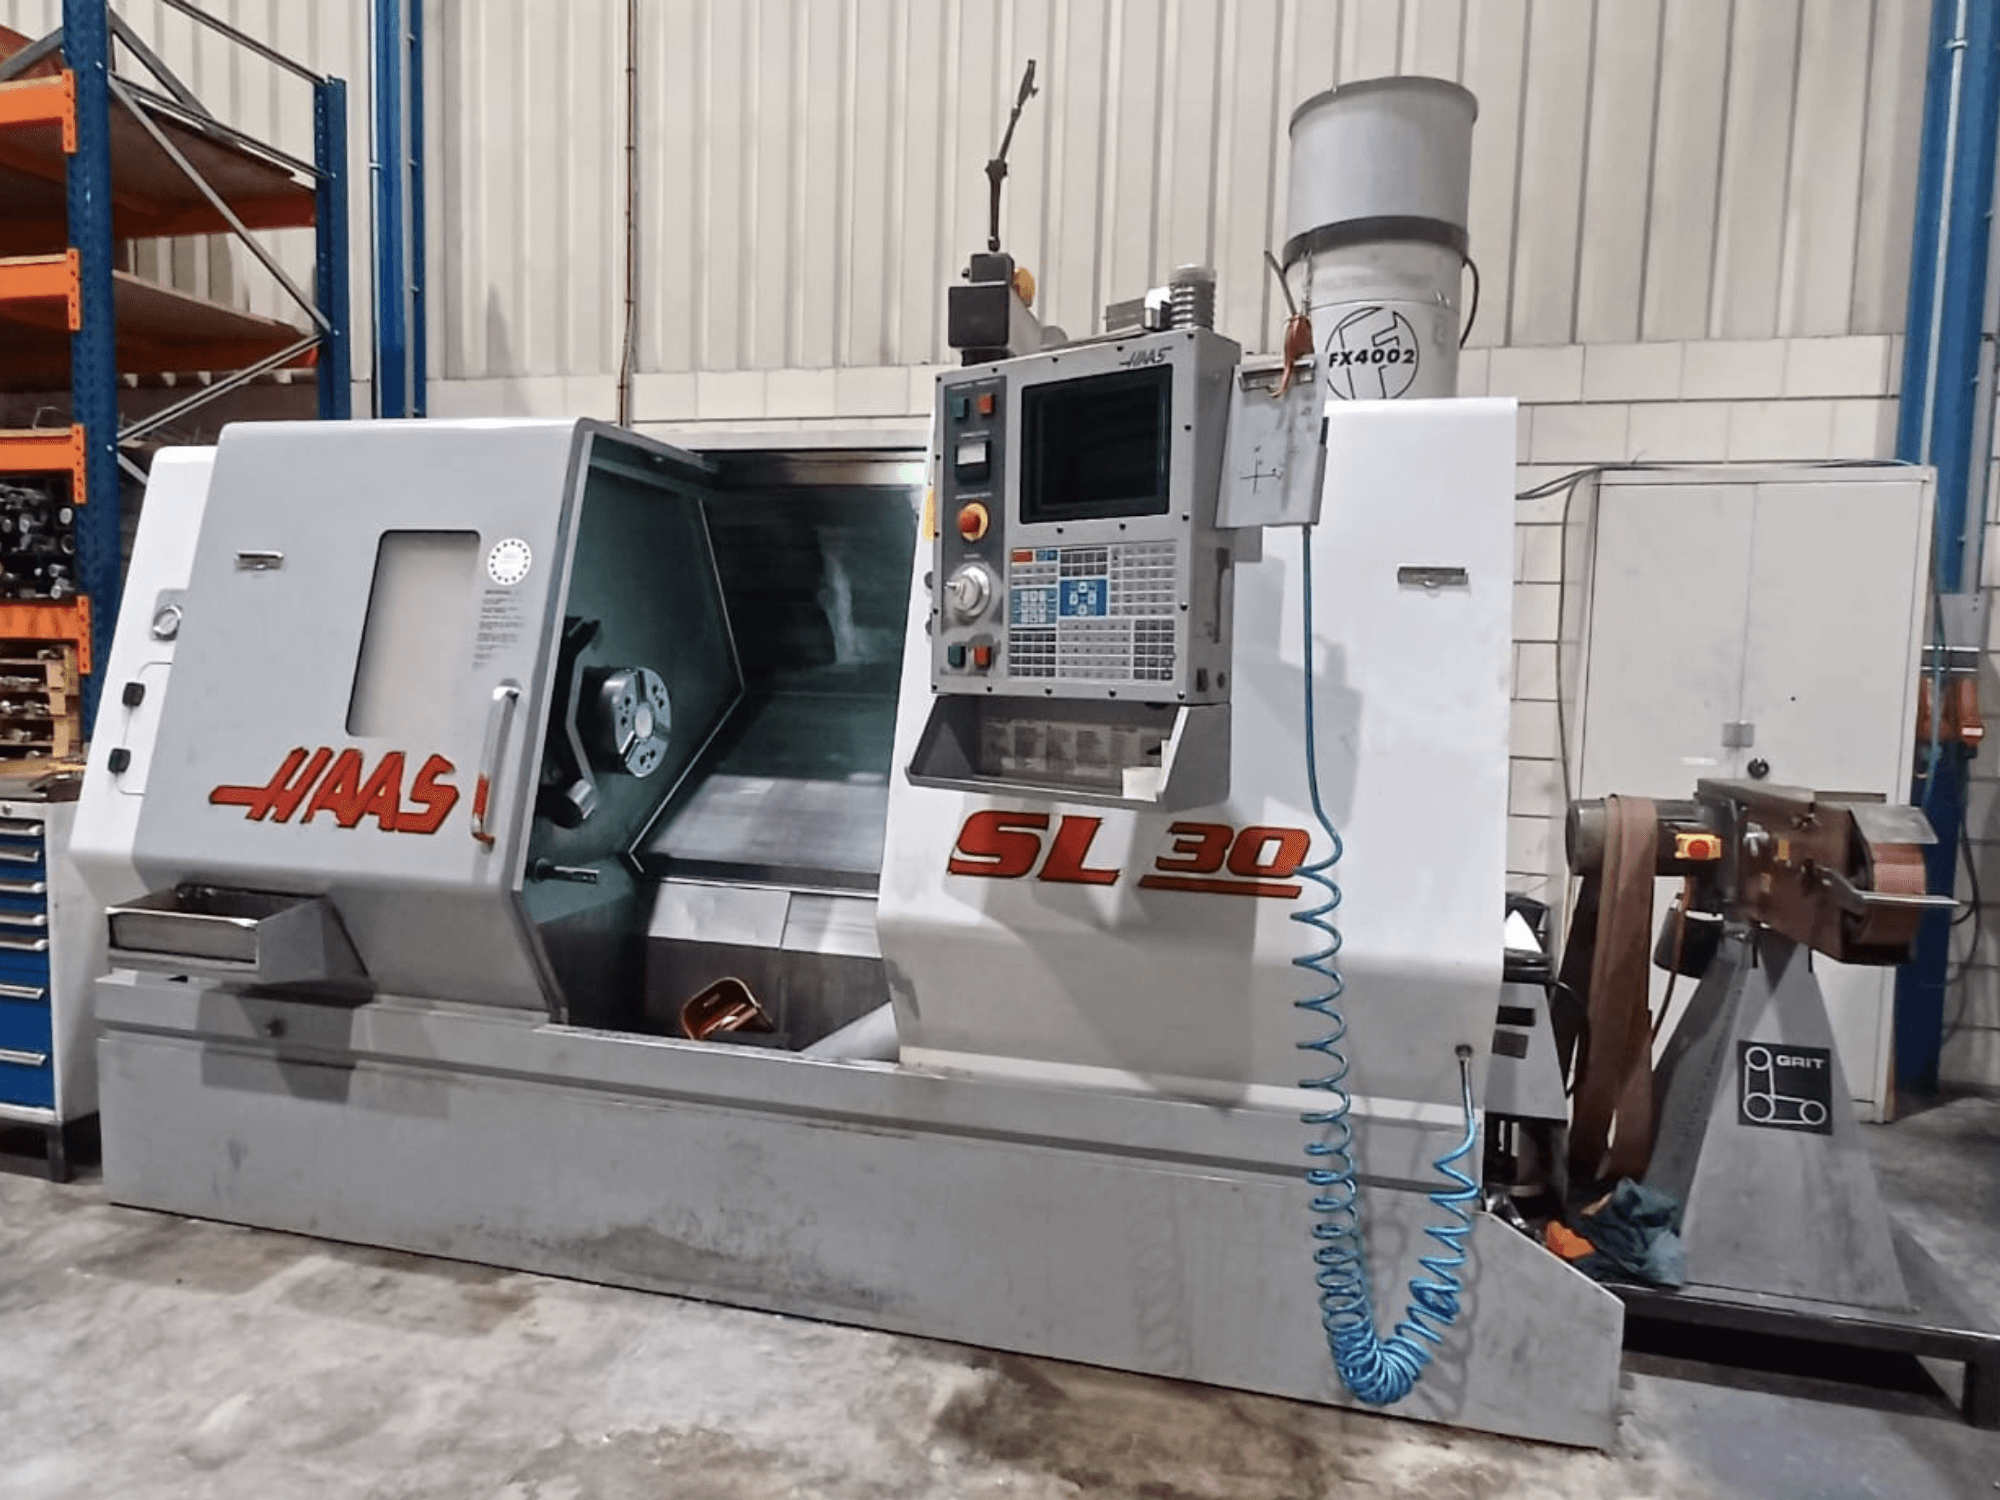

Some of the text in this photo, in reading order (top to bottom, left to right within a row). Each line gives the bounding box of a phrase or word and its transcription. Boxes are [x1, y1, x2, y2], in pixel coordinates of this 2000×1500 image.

[1328, 348, 1415, 368] FX4002
[209, 747, 459, 834] HAAS
[947, 810, 1311, 886] SL 30
[1776, 1054, 1826, 1070] GRIT
